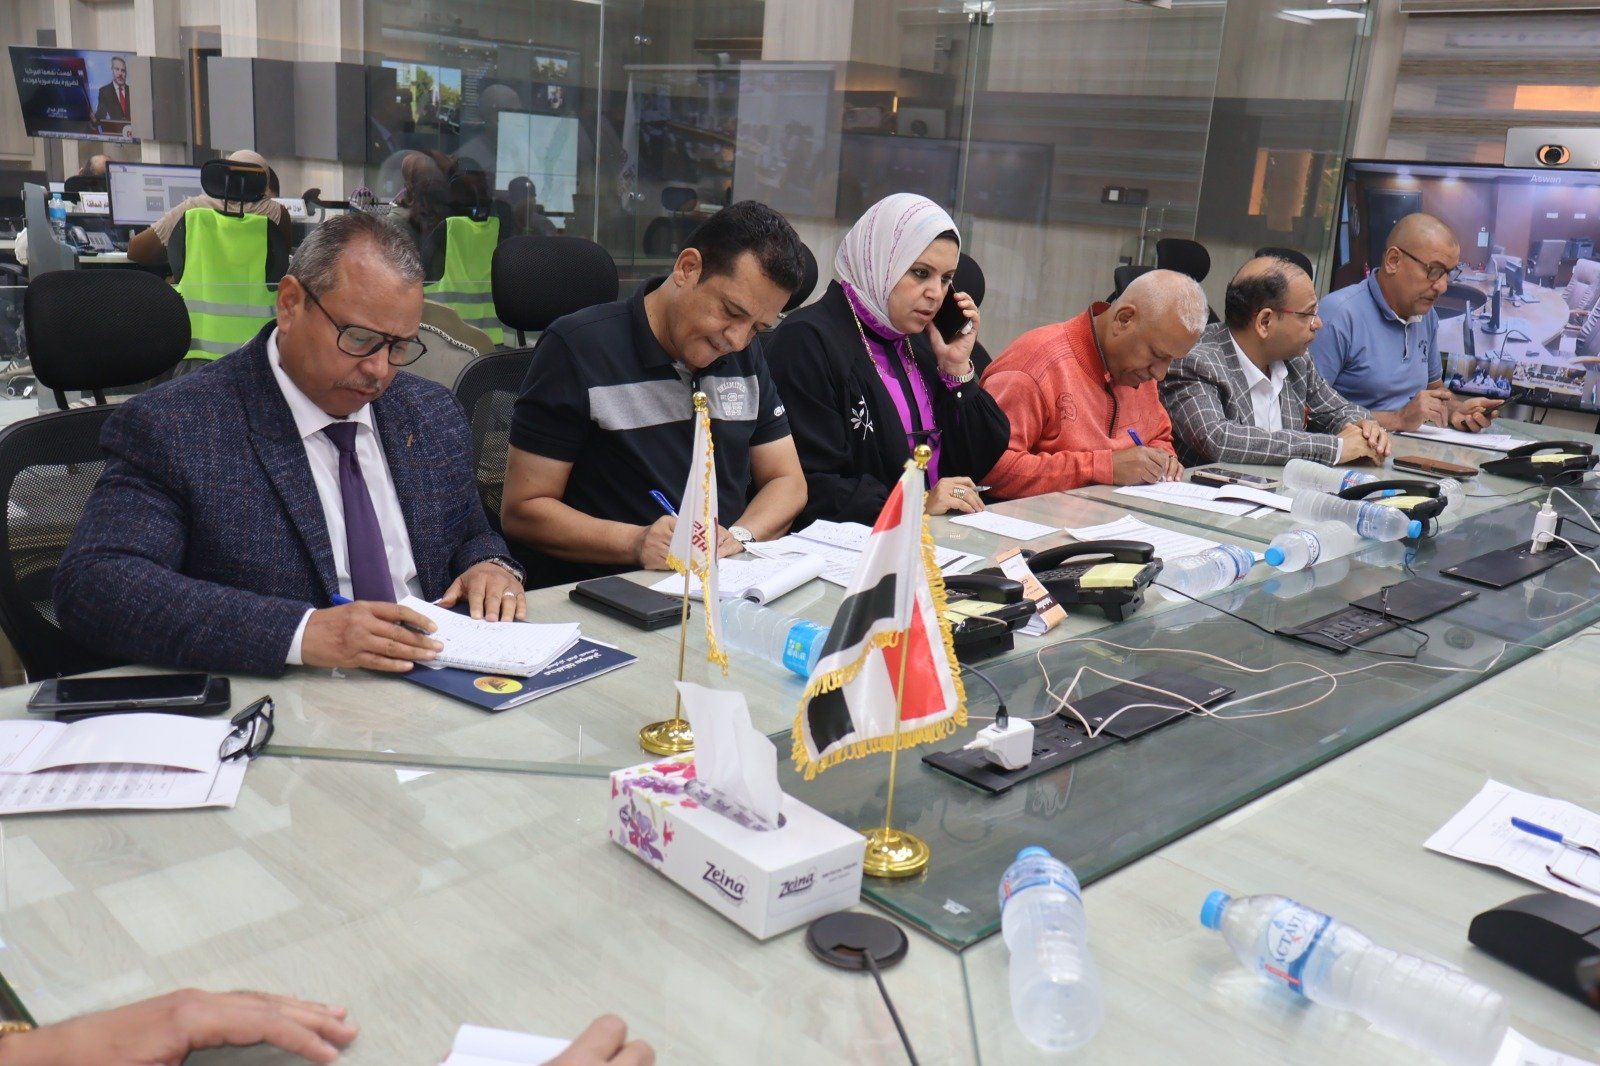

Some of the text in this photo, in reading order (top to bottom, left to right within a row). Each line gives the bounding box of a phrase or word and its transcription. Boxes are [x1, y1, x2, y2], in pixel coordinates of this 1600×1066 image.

[1530, 174, 1561, 183] Aswan
[702, 861, 745, 900] Zeina
[778, 873, 815, 898] Zeina
